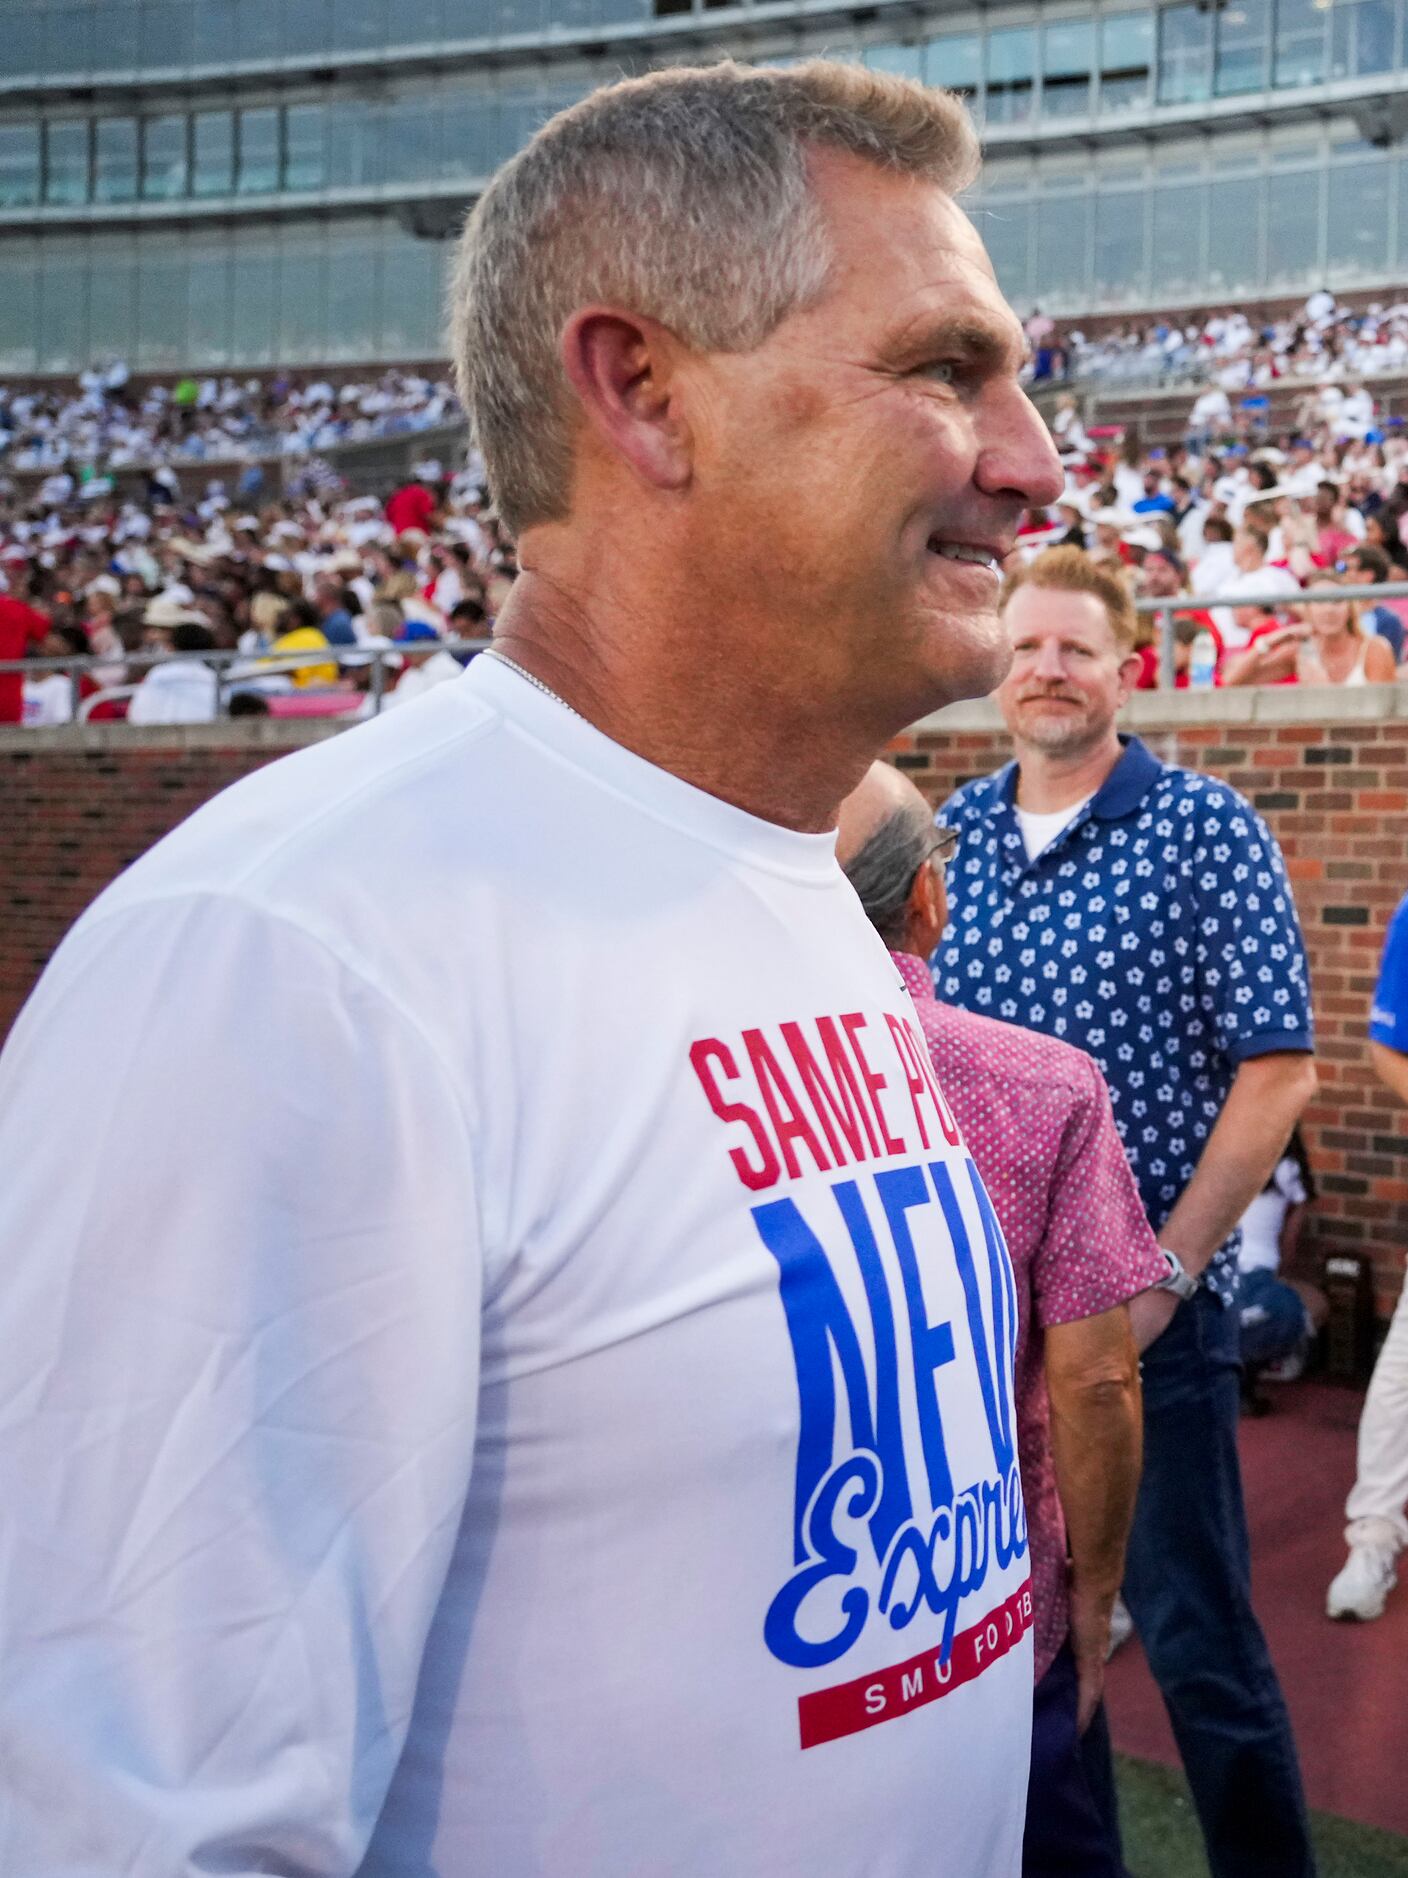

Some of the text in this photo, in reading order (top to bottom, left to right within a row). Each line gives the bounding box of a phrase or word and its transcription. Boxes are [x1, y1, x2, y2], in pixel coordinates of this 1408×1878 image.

[689, 1012, 907, 1191] SAME
[764, 1456, 1028, 1668] Expre
[864, 1657, 952, 1714] SMU
